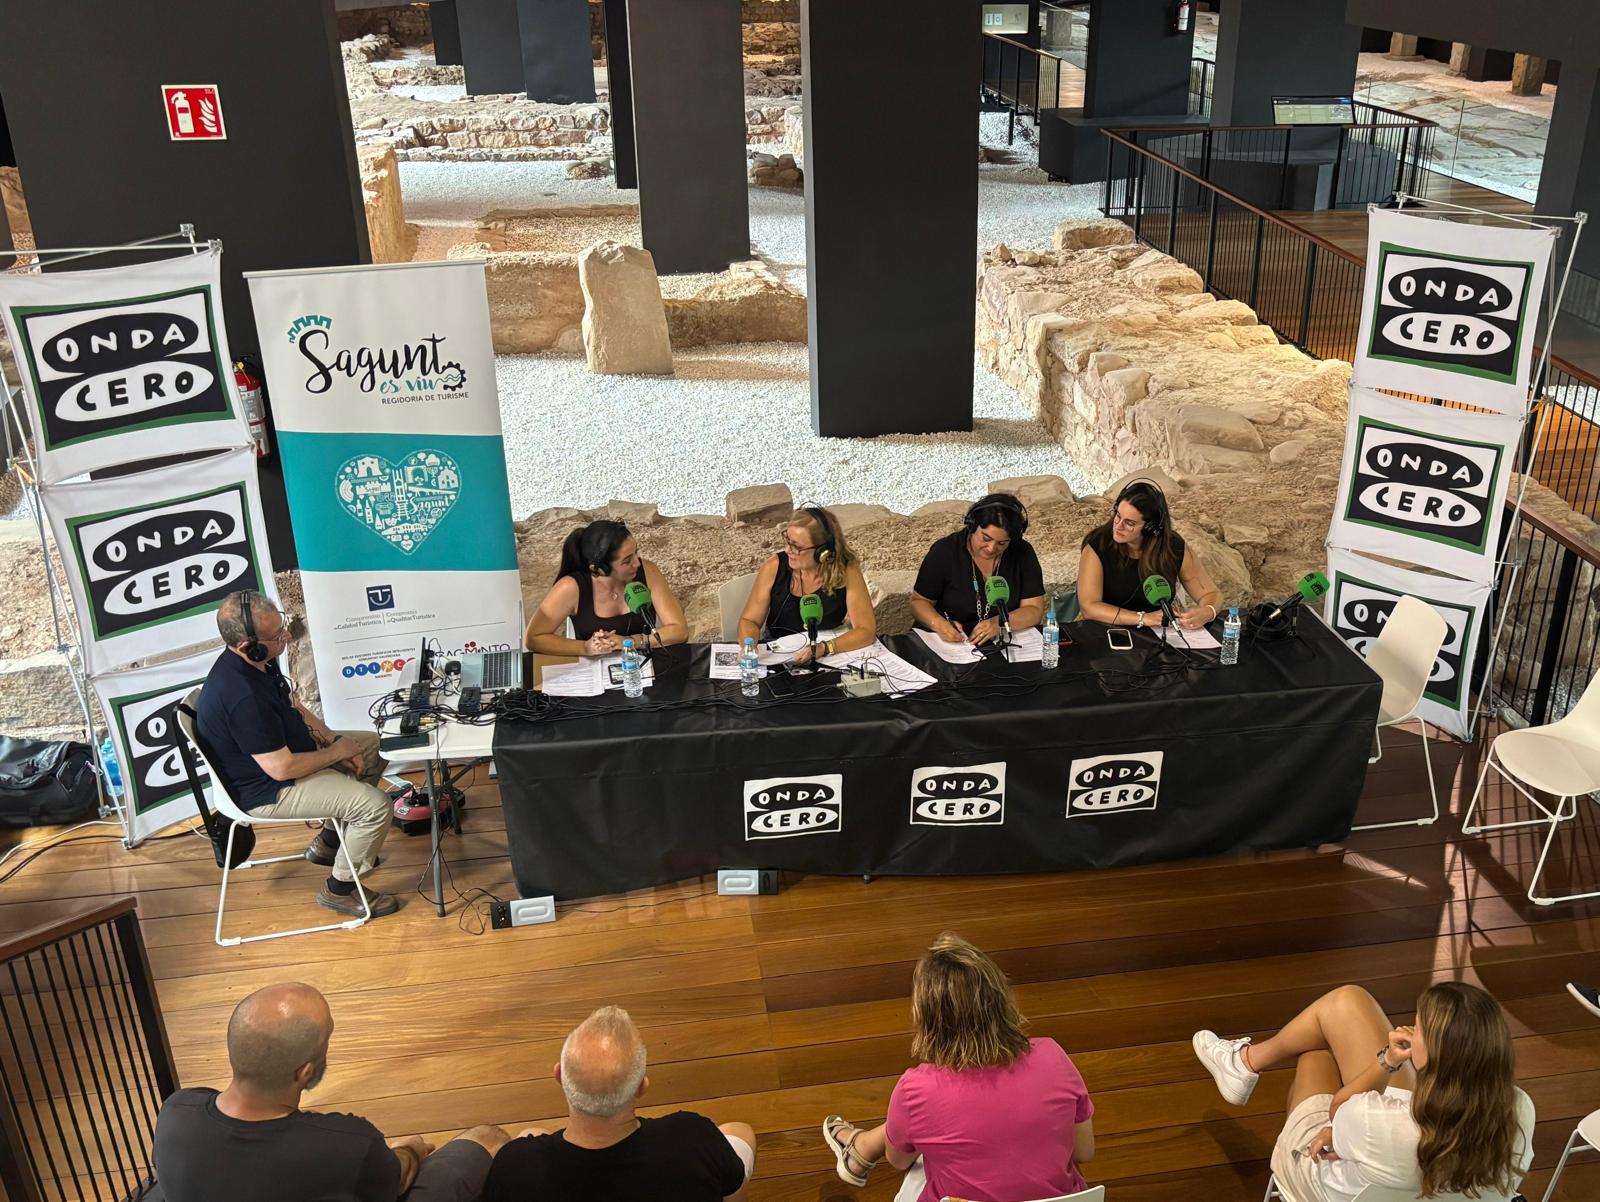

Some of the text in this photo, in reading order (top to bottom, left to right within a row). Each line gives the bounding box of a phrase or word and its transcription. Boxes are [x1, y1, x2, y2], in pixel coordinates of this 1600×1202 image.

[1399, 275, 1499, 307] ONDA
[56, 323, 186, 363] ONDA
[1399, 317, 1495, 350] CERO
[76, 370, 194, 411] CERO
[379, 377, 437, 394] es viu
[381, 396, 424, 405] REGIDORIA
[437, 391, 470, 401] TURISME
[1376, 448, 1471, 483] ONDA
[409, 495, 450, 515] Sagunt
[1375, 486, 1466, 522] CERO
[105, 518, 223, 563] ONDA
[123, 559, 231, 605] CERO
[1083, 764, 1147, 783] ONDA
[924, 777, 991, 793] ONDA
[757, 788, 828, 806] ONDA
[1084, 787, 1145, 807] CERO
[927, 800, 991, 817] CERO
[762, 810, 828, 829] CERO
